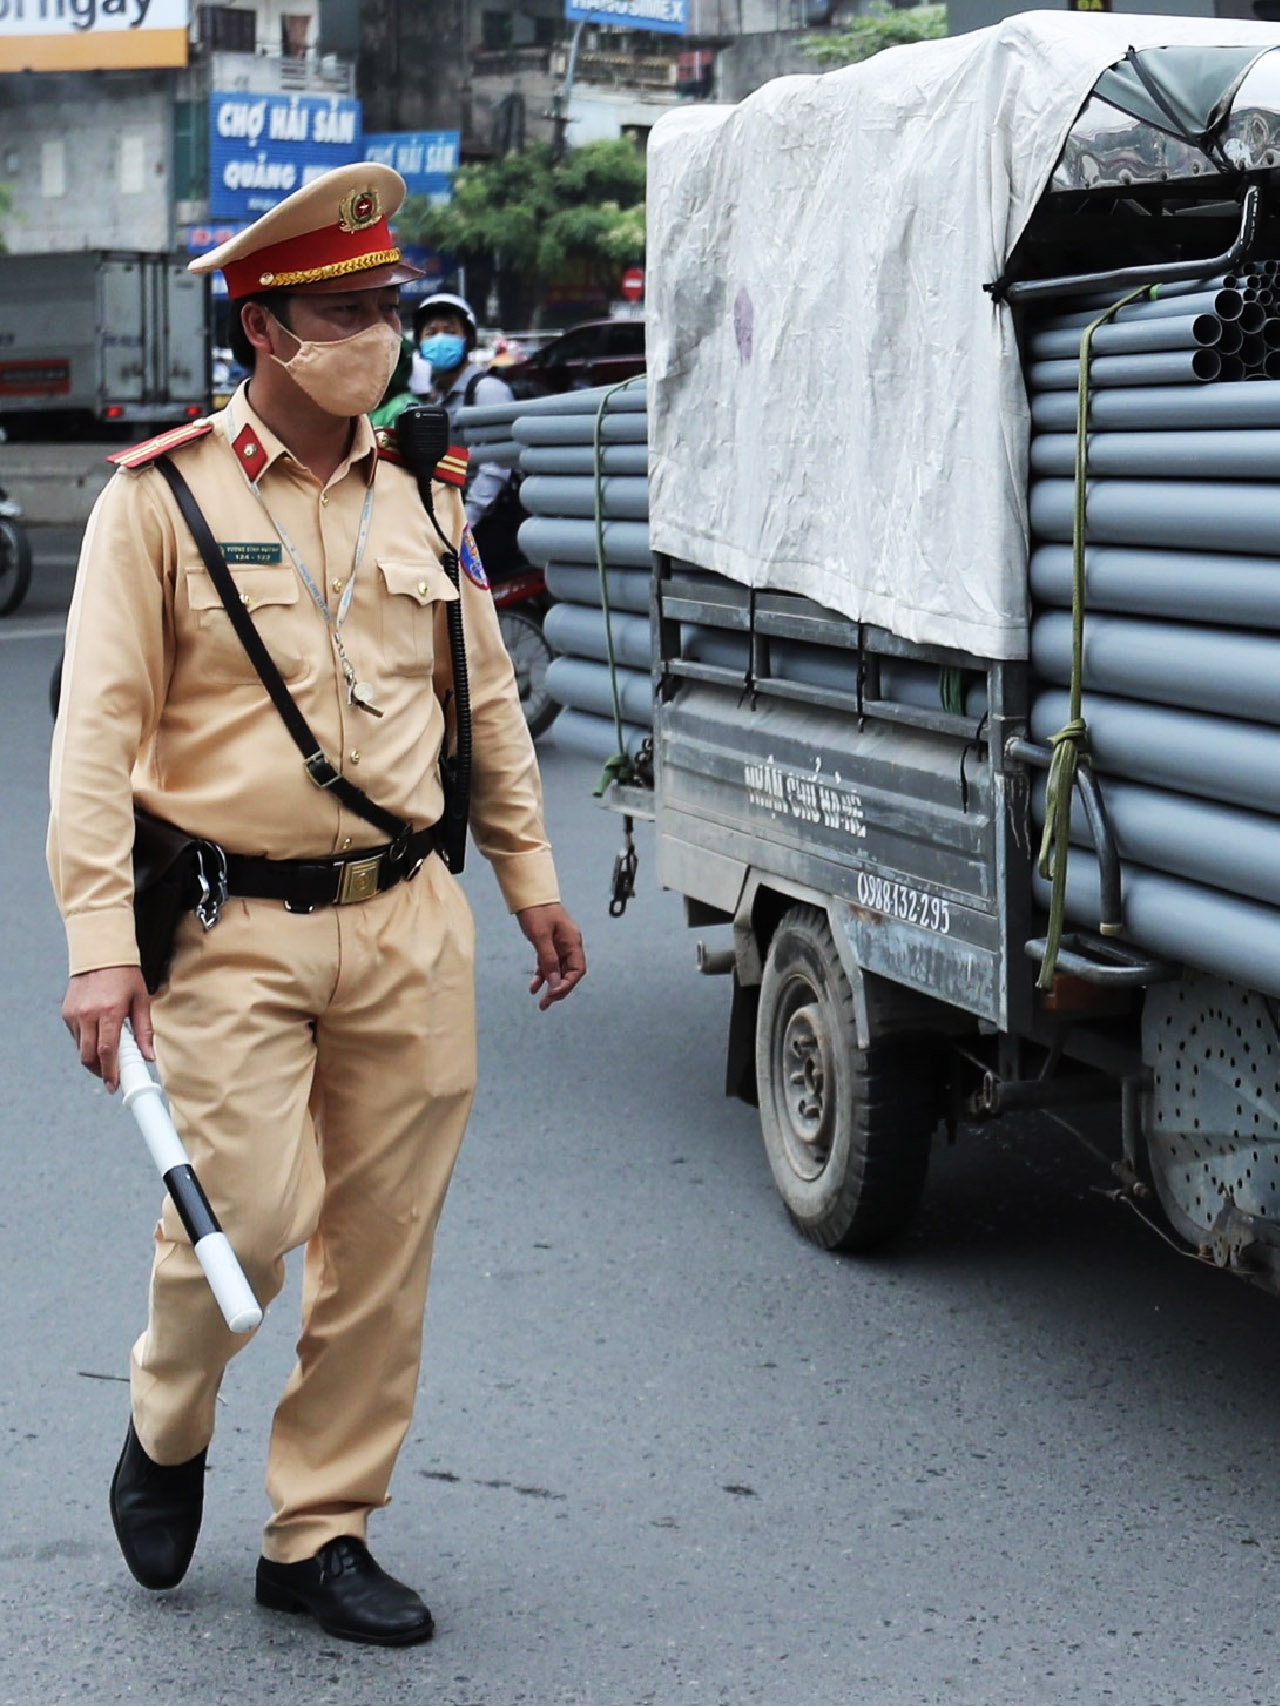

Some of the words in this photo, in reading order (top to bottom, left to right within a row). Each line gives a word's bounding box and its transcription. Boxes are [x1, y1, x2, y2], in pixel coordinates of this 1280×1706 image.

[217, 101, 266, 147] CHỢ
[269, 94, 309, 141] HẢI
[313, 97, 357, 144] SẢN
[223, 152, 296, 190] QUẢNG
